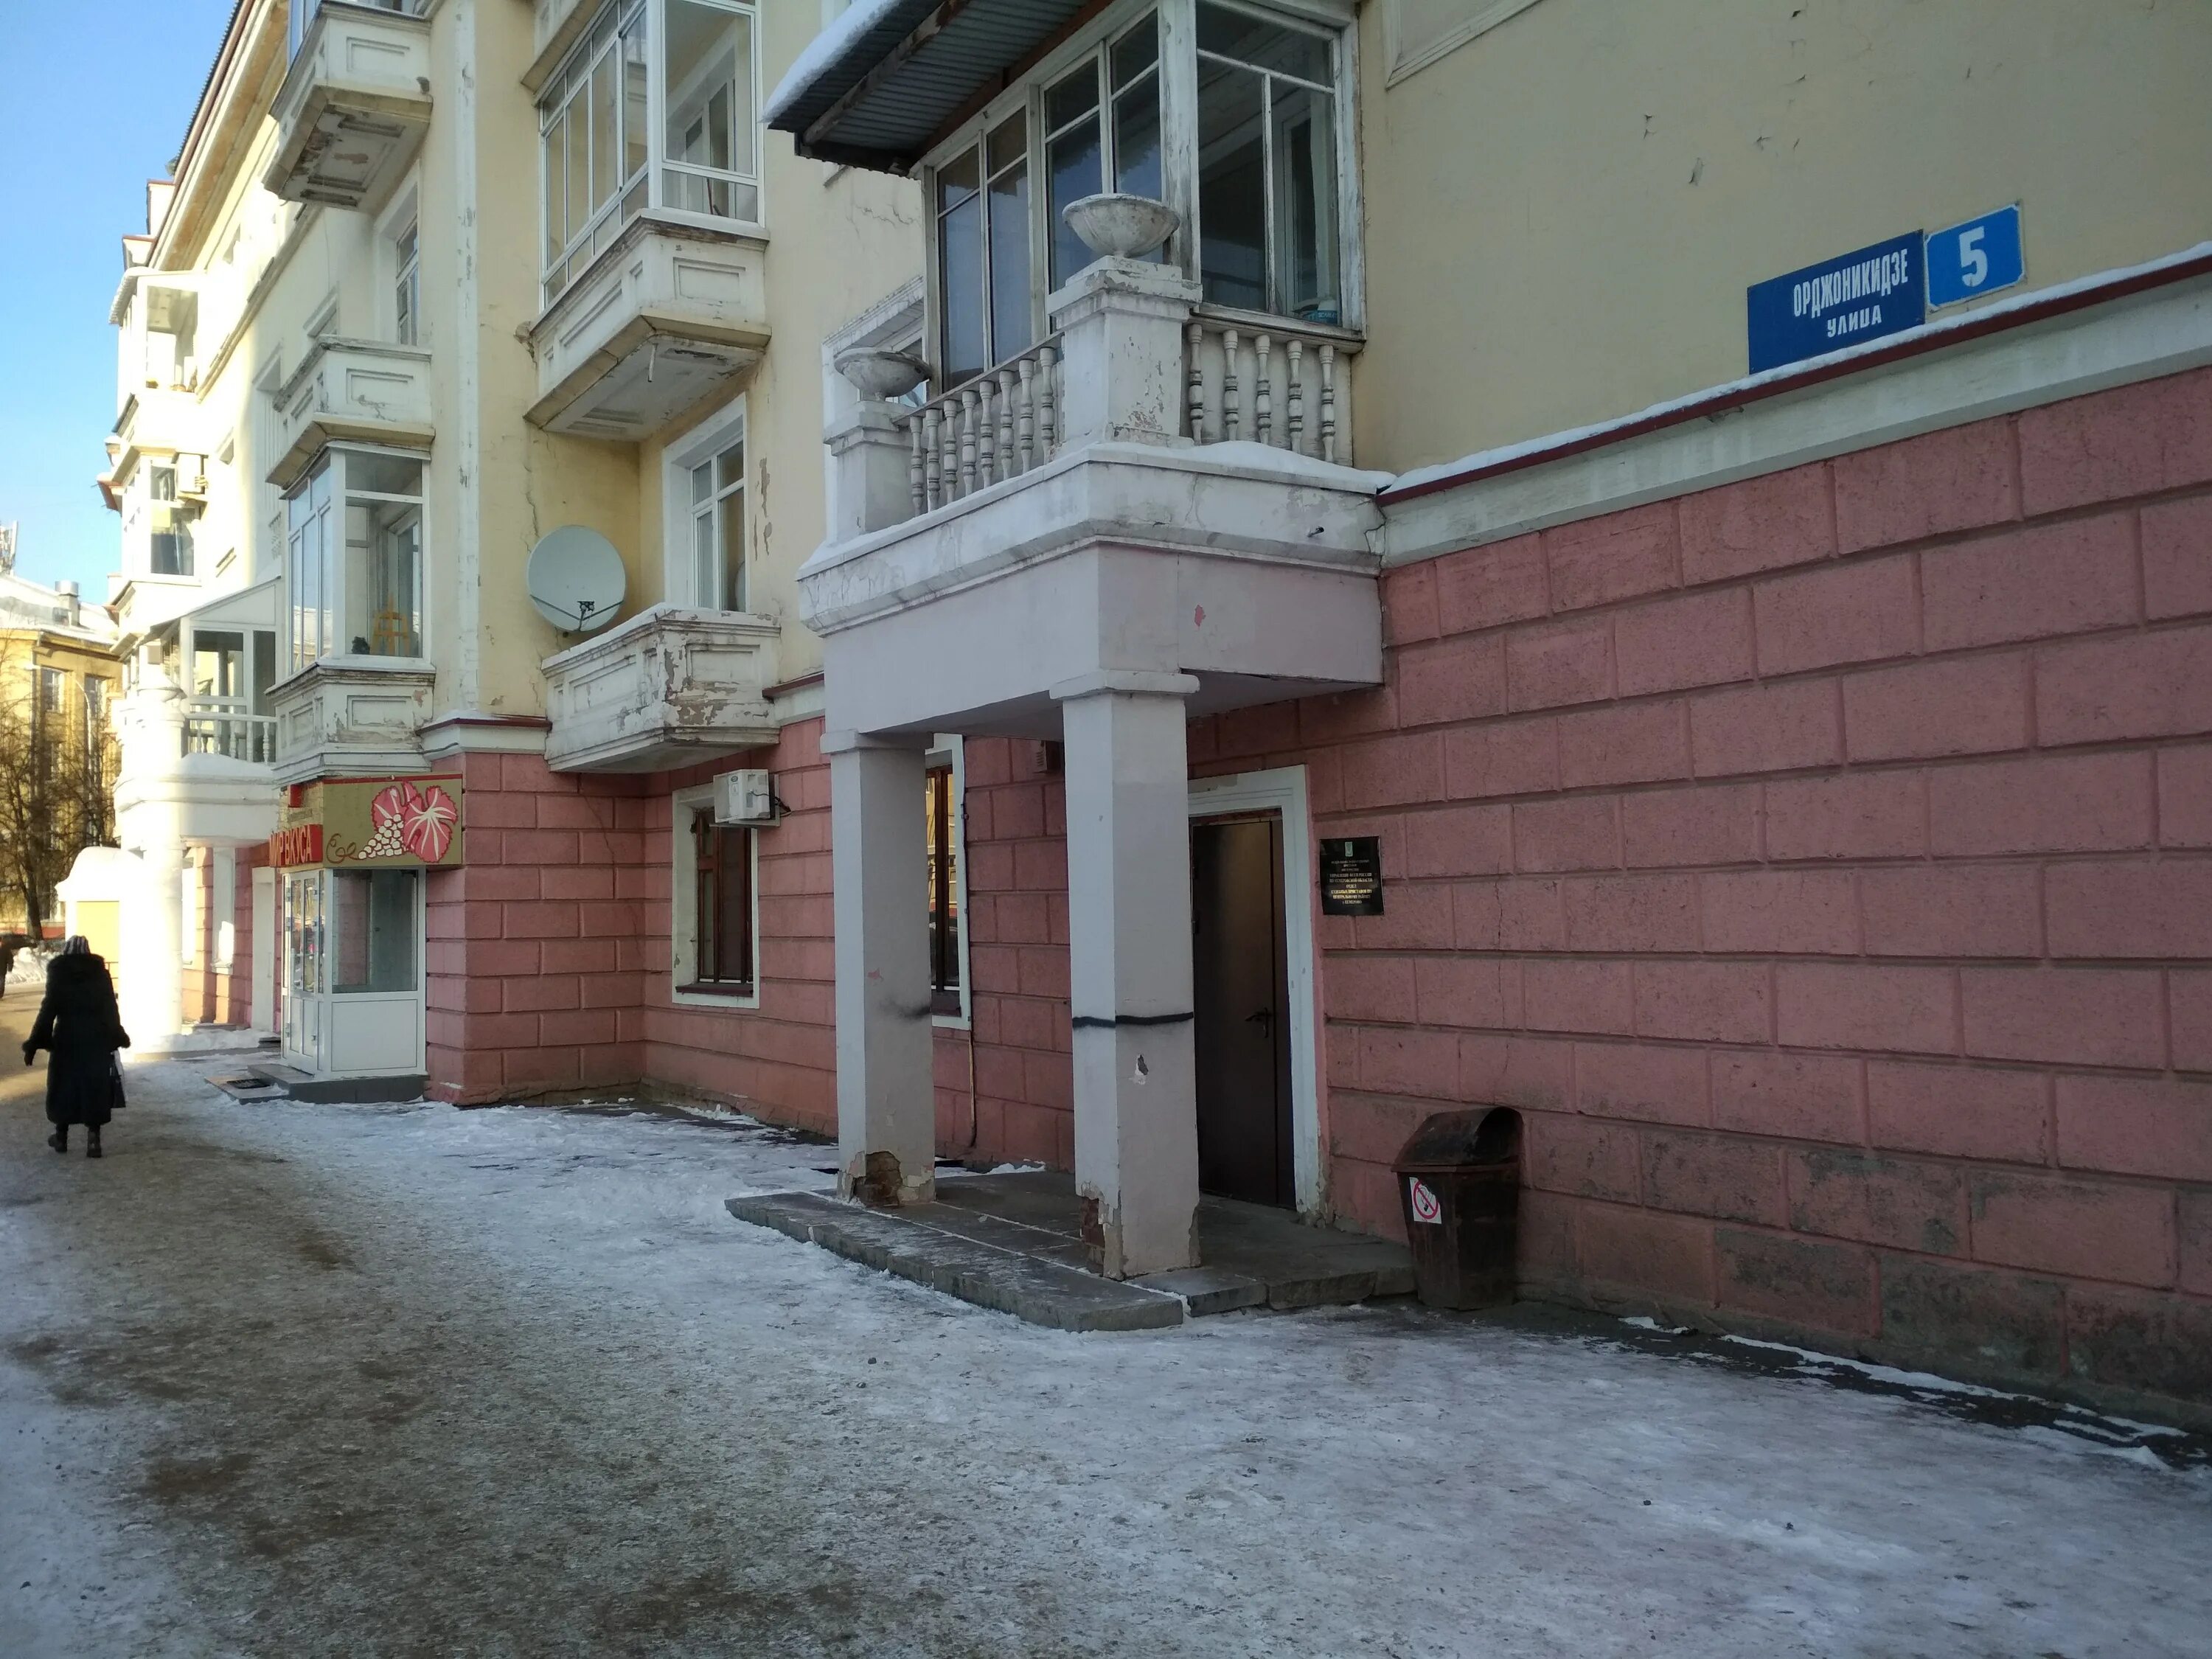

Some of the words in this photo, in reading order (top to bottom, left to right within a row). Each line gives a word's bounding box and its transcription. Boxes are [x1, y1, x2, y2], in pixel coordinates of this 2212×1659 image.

[1958, 225, 1989, 288] 5
[1792, 248, 1908, 319] ОРДЖОНИКИДЗЕ
[1826, 305, 1882, 338] УЛИЦА
[285, 823, 312, 866] ВКУСА
